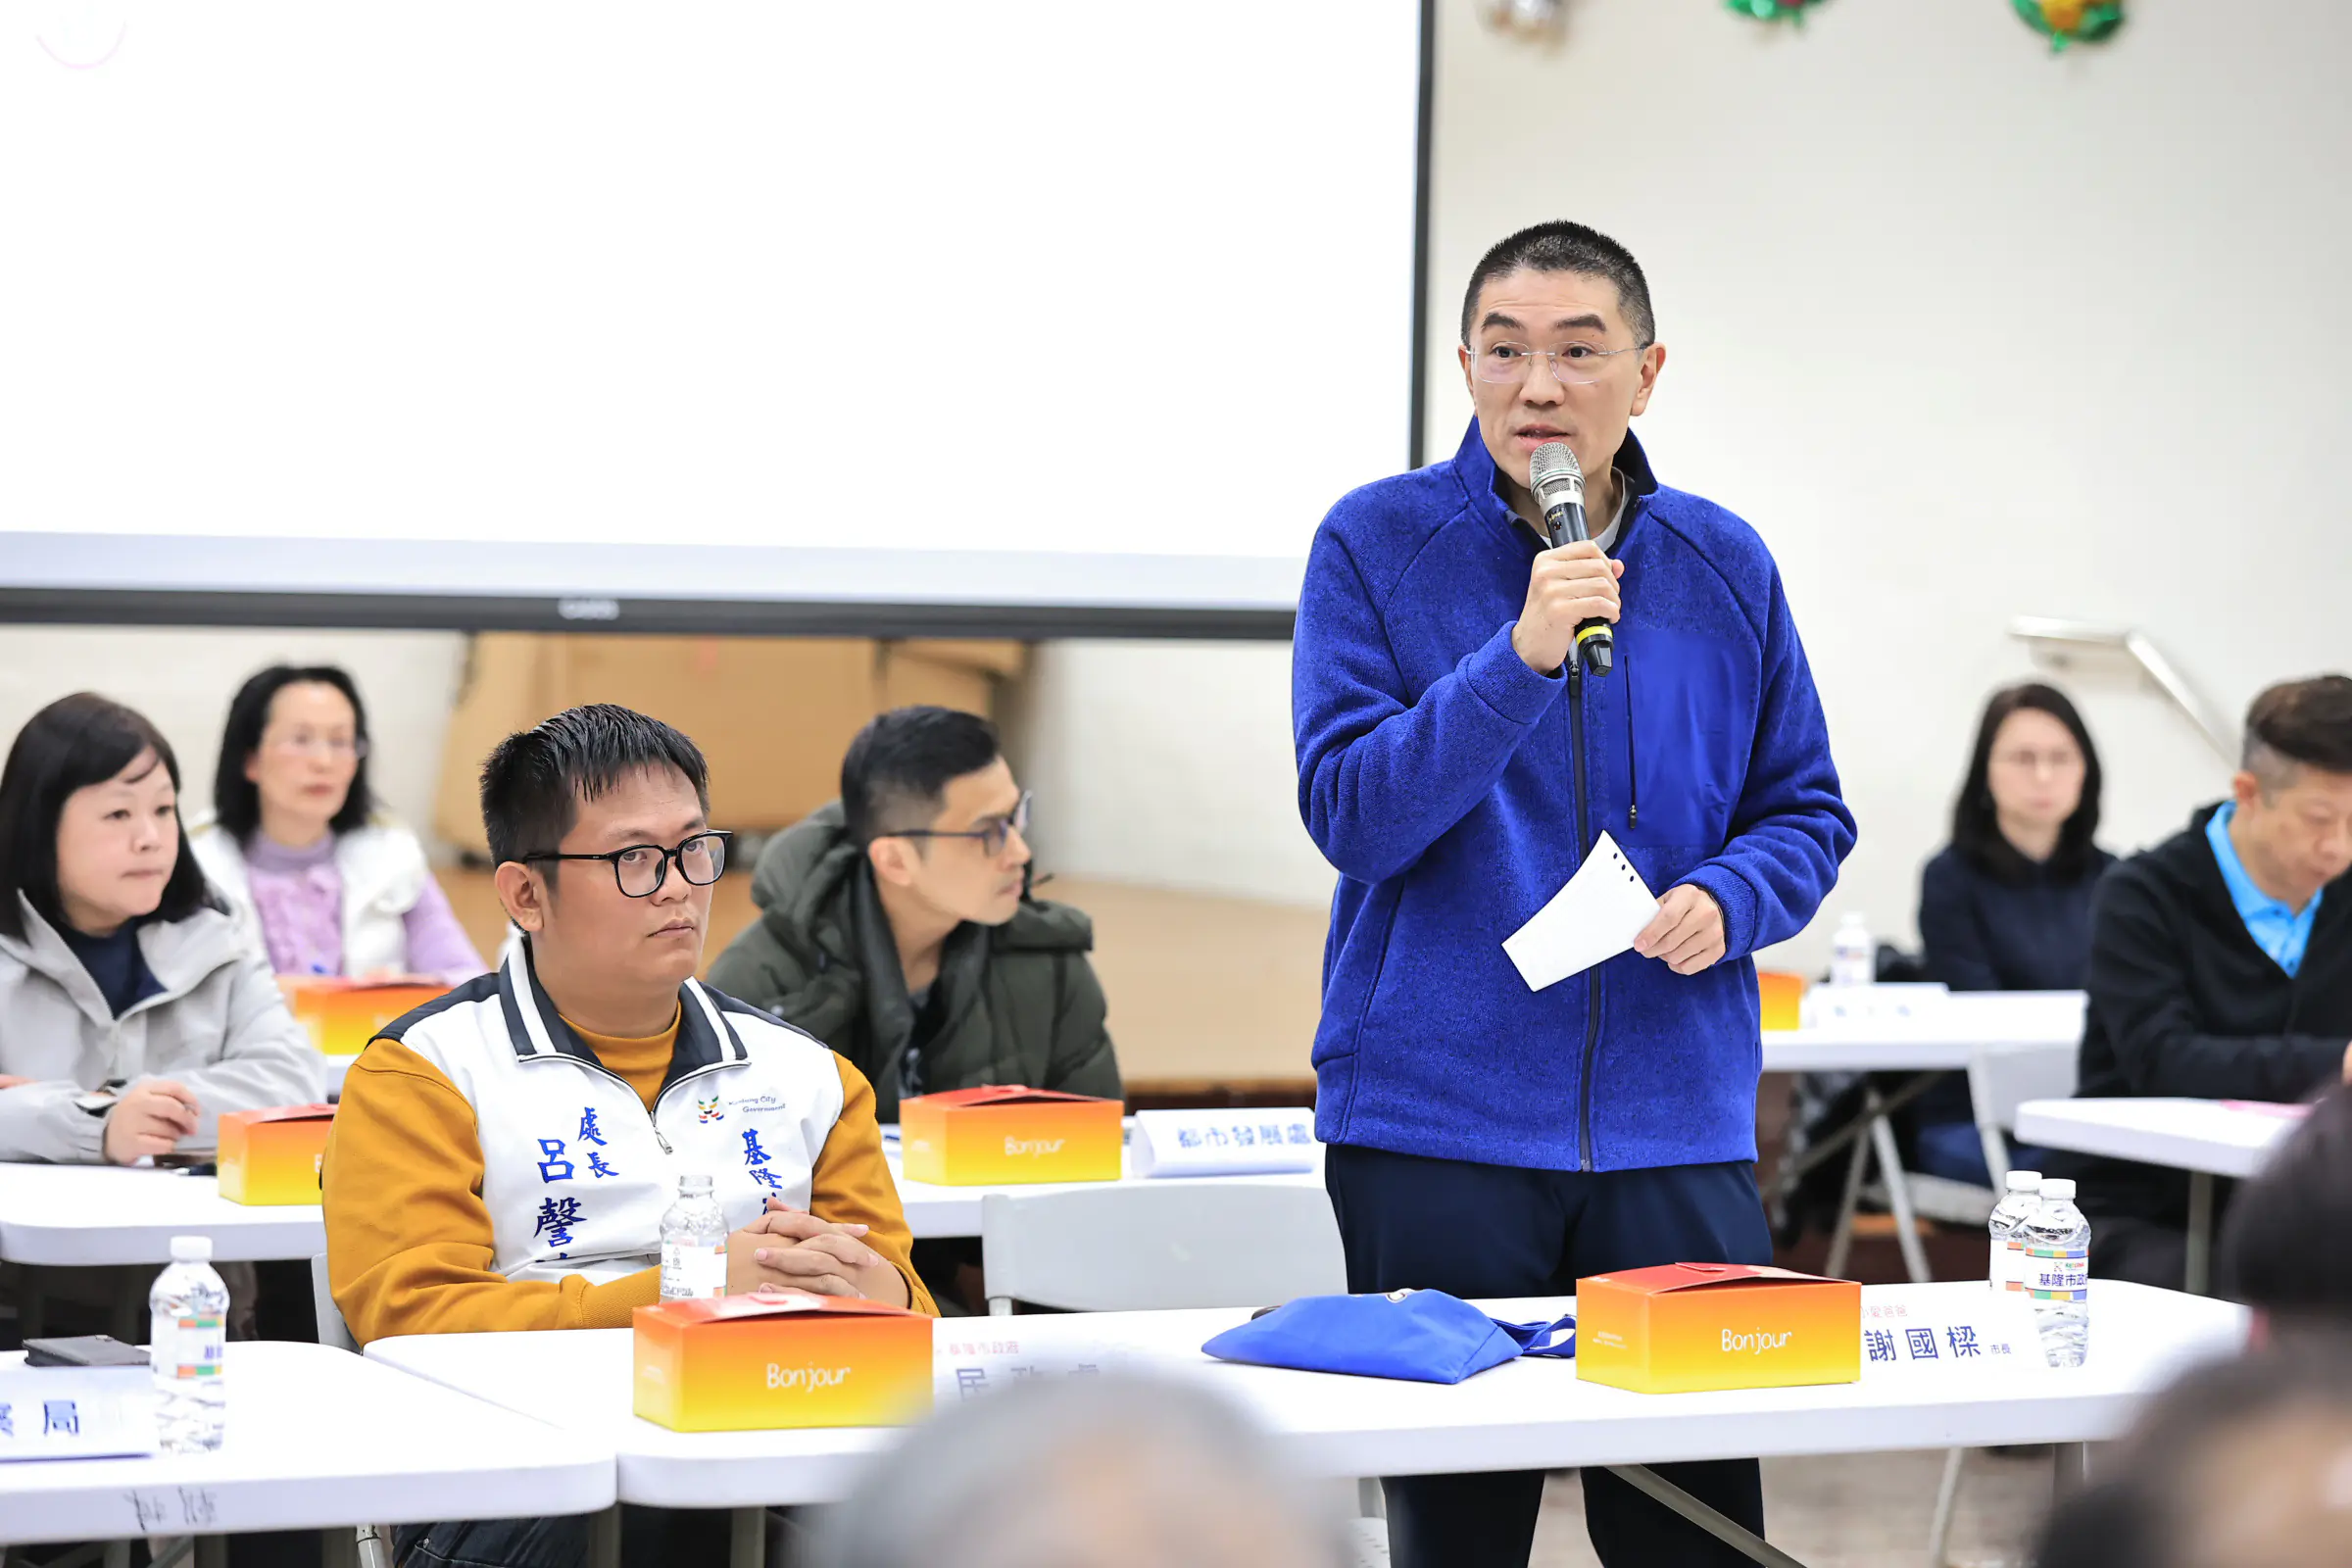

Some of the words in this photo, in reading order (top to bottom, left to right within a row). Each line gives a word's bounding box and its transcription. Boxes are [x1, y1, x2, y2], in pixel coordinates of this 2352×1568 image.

[577, 1106, 619, 1178] 處長
[741, 1128, 783, 1215] 基隆
[533, 1138, 588, 1263] 呂謦
[2039, 1273, 2088, 1287] 基隆市政
[1721, 1326, 1792, 1355] Bonjour
[1864, 1325, 1982, 1362] 謝國樑
[1989, 1343, 2012, 1355] 市長
[766, 1360, 852, 1394] Bonjour
